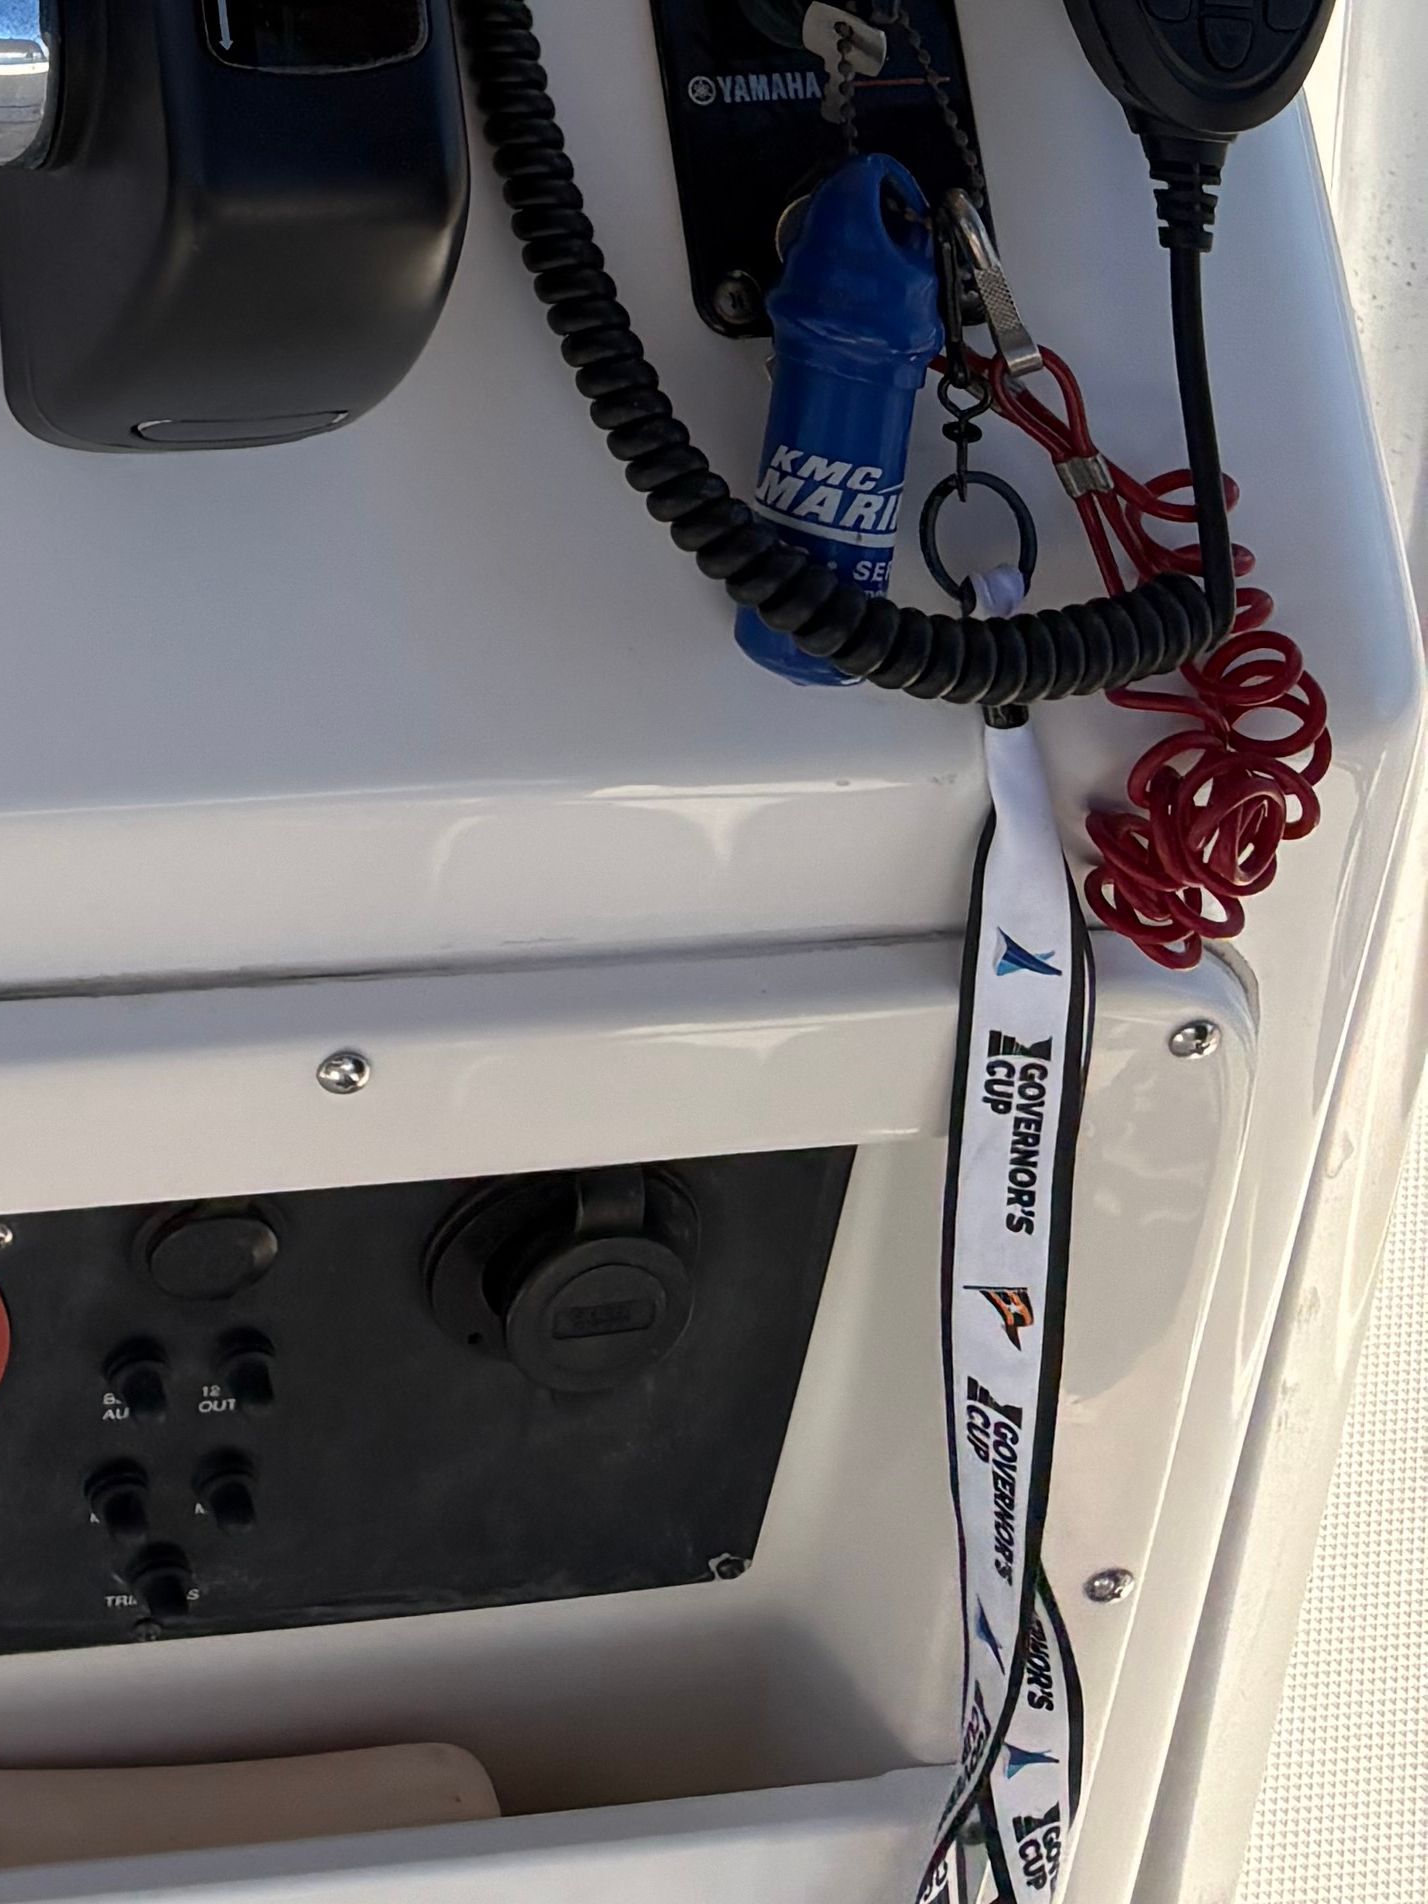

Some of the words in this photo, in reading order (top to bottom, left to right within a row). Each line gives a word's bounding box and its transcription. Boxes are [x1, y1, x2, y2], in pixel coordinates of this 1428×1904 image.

[716, 71, 822, 104] YAMAHA
[769, 444, 884, 492] KMC
[980, 1059, 1016, 1116] CUP
[1005, 1062, 1049, 1236] GOVERNOR'S
[966, 1404, 992, 1463] CUP
[1018, 1838, 1048, 1890] CUP
